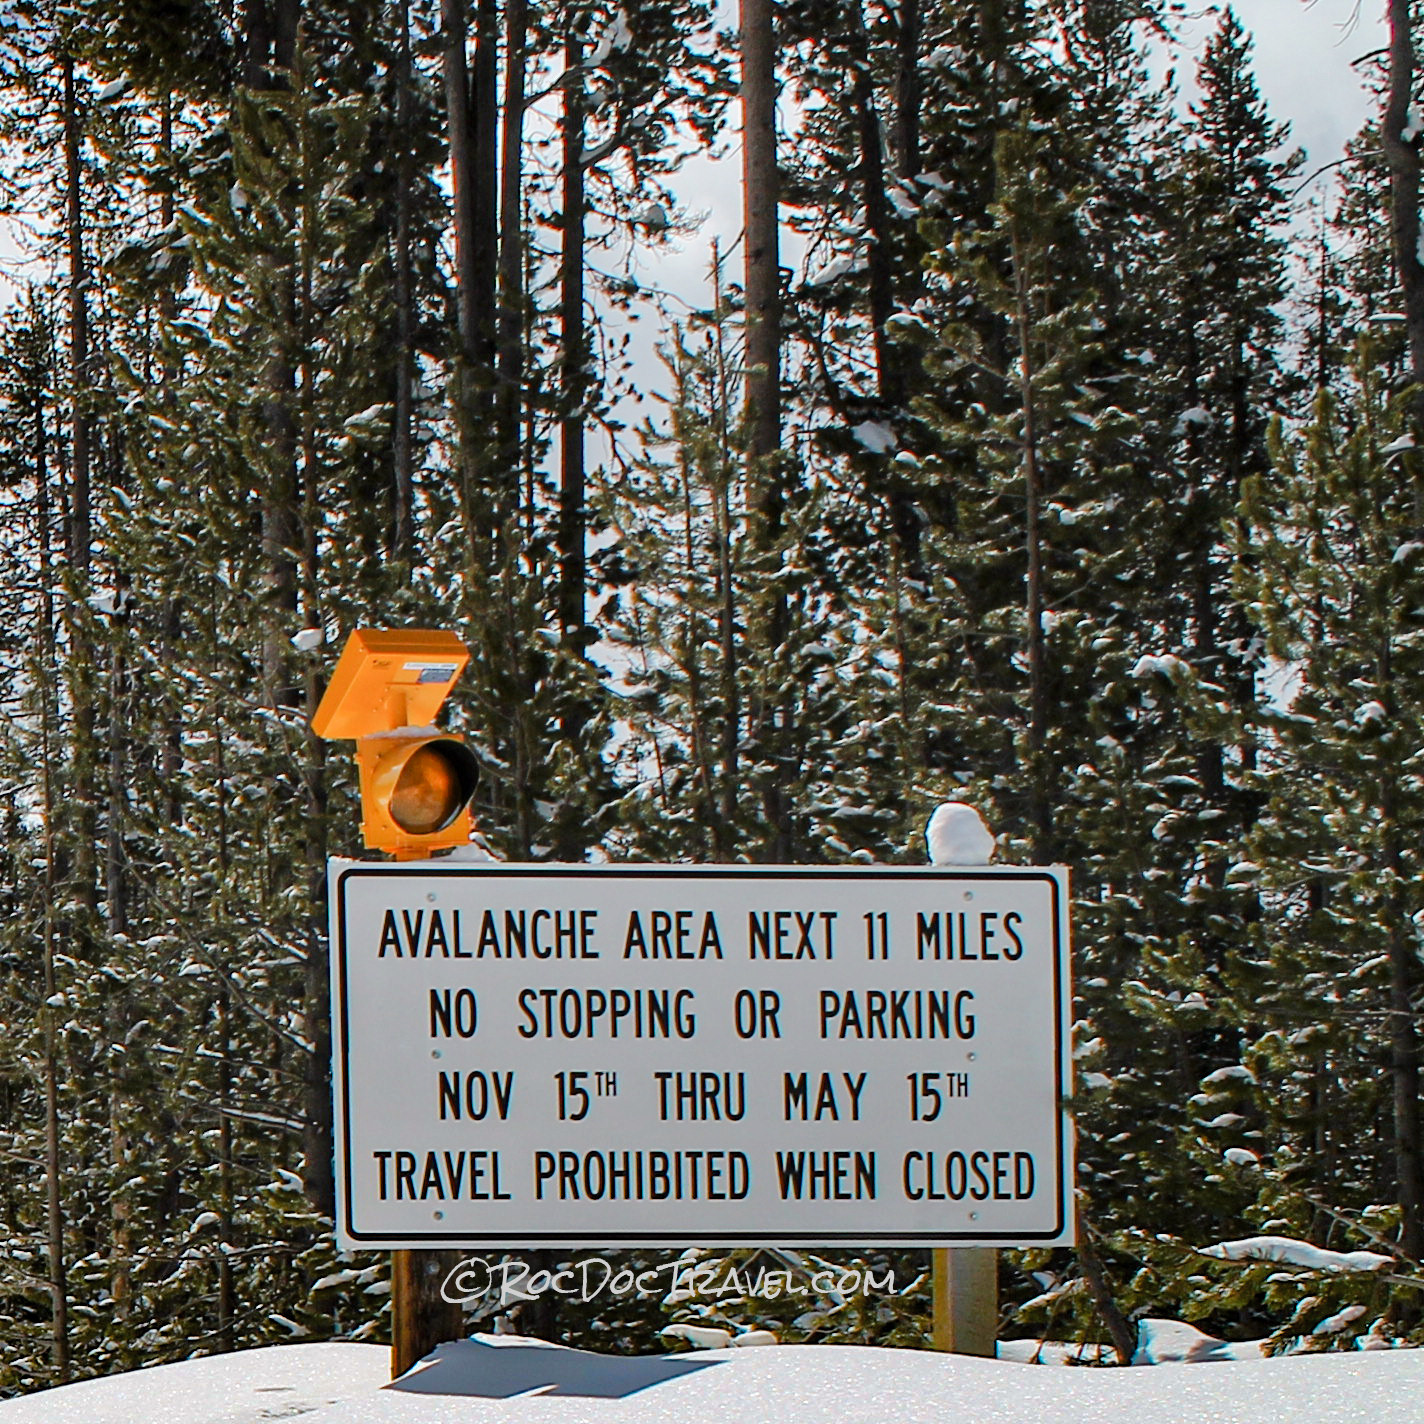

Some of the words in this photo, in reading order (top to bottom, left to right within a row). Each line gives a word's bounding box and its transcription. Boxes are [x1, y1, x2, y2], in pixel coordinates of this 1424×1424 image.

[379, 910, 599, 958] AVALANCHE
[624, 911, 722, 959] AREA
[750, 912, 837, 959] NEXT
[864, 912, 888, 959] 11
[917, 912, 1022, 960] MILES
[430, 989, 476, 1038] NO
[519, 989, 694, 1038] STOPPING
[735, 990, 780, 1038] OR
[821, 991, 974, 1039] PARKING
[440, 1071, 513, 1120] NOV
[555, 1072, 616, 1120] 15TH
[655, 1072, 744, 1121] THRU
[785, 1073, 866, 1120] MAY
[907, 1073, 967, 1121] 15TH
[374, 1152, 511, 1200] TRAVEL
[536, 1151, 749, 1200] PROHIBITED
[776, 1152, 875, 1199] WHEN
[904, 1151, 1034, 1200] CLOSED
